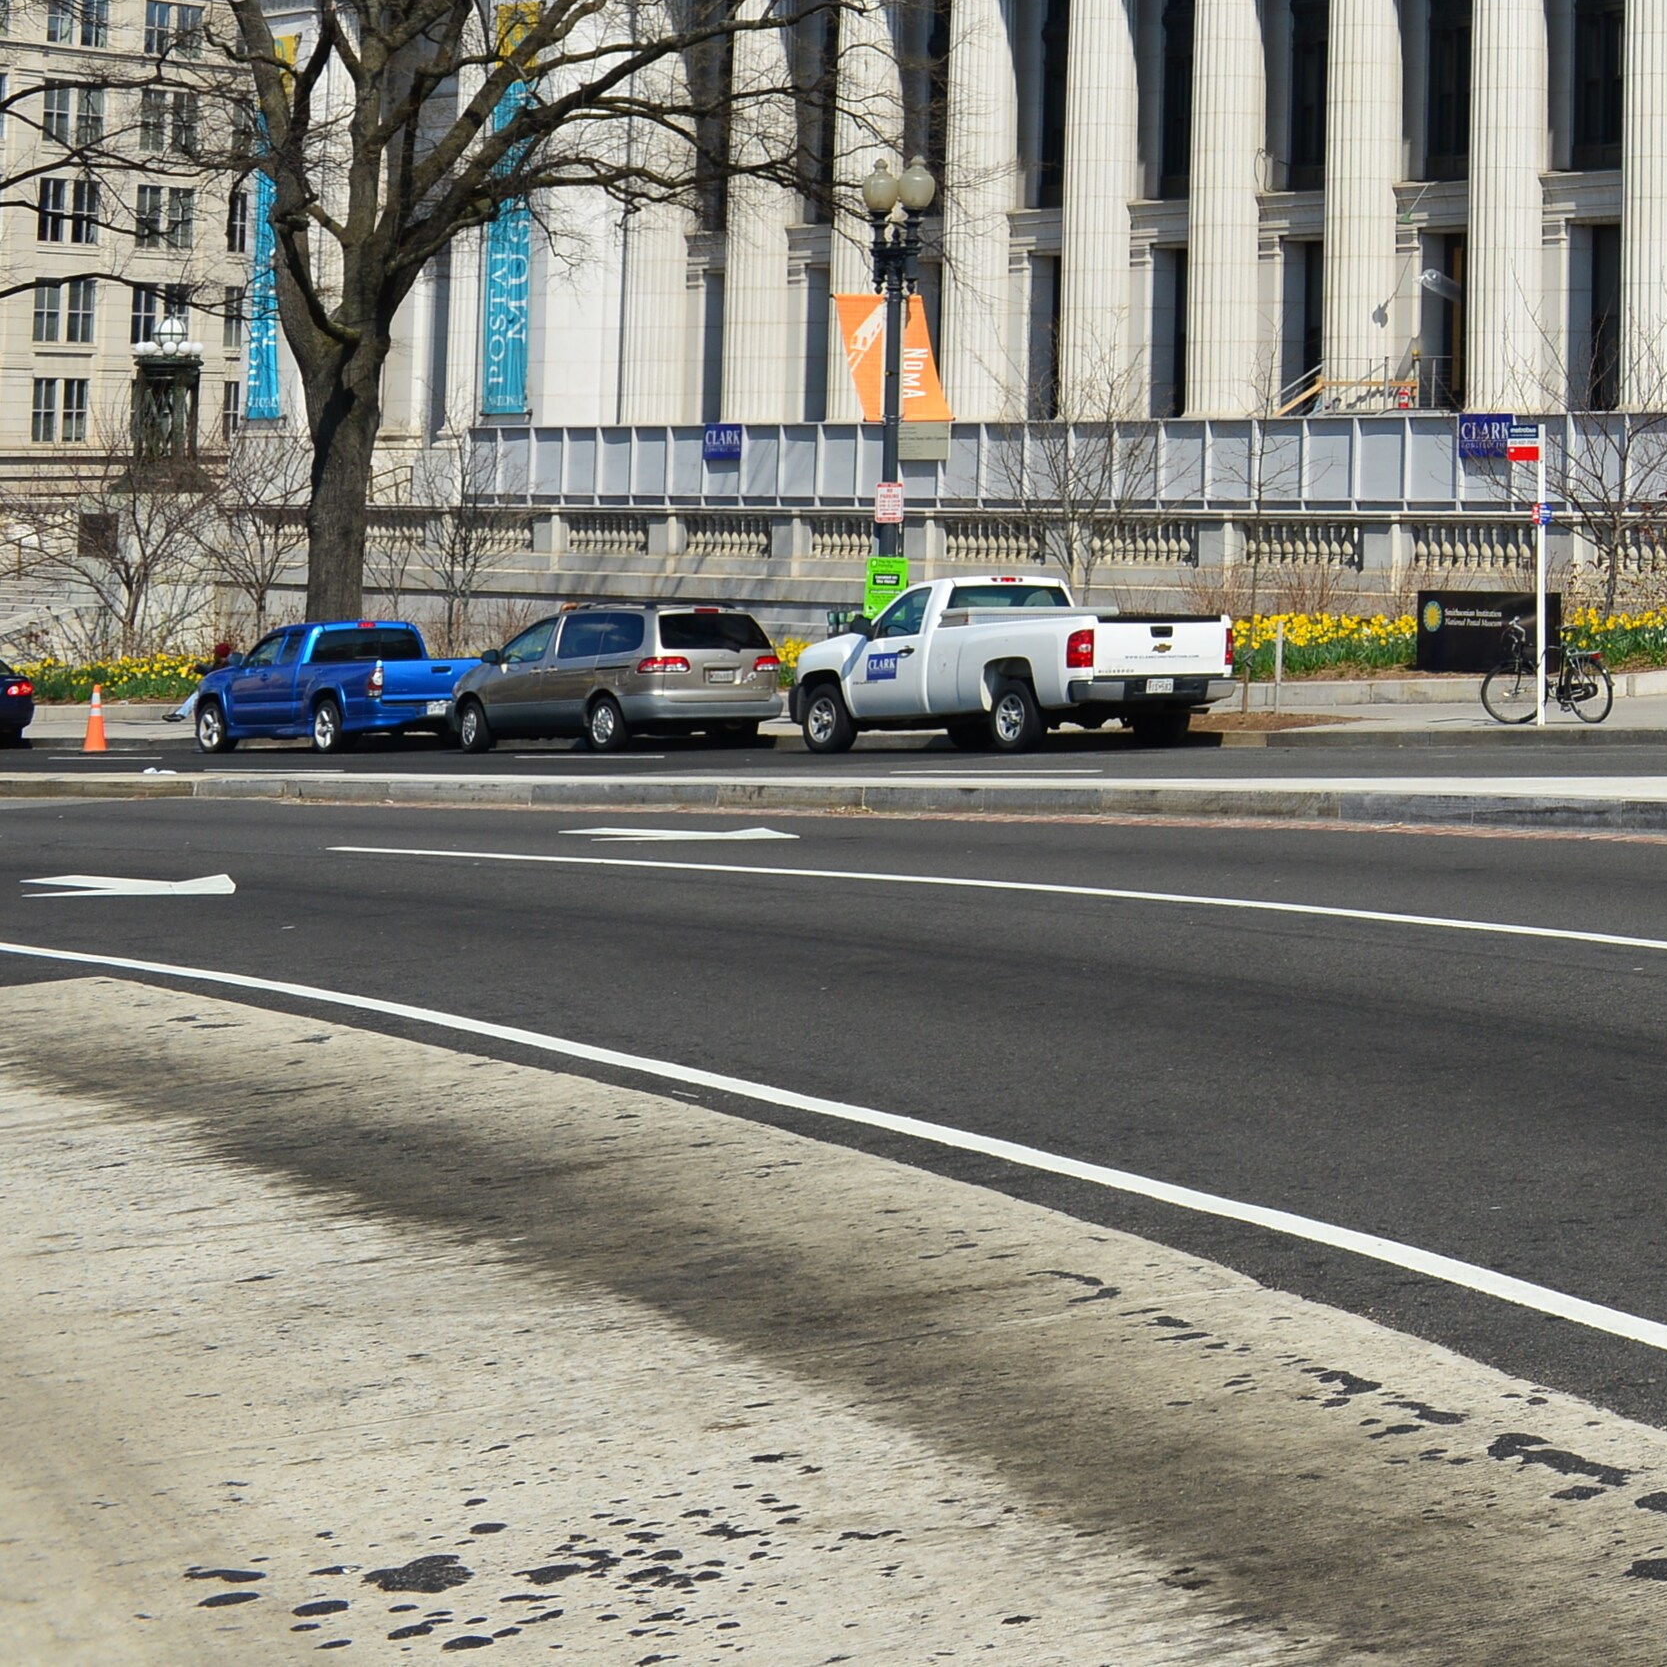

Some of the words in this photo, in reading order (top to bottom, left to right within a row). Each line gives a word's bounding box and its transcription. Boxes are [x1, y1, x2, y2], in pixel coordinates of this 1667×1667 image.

[902, 348, 928, 399] NOMA
[705, 430, 740, 445] CLARK
[1461, 422, 1510, 440] CLARK
[1444, 608, 1475, 616] Smithsonian
[1476, 609, 1502, 617] Institution
[1445, 618, 1466, 626] National
[1466, 618, 1480, 626] Postal
[1481, 619, 1502, 627] Museum
[868, 658, 896, 670] CLARK
